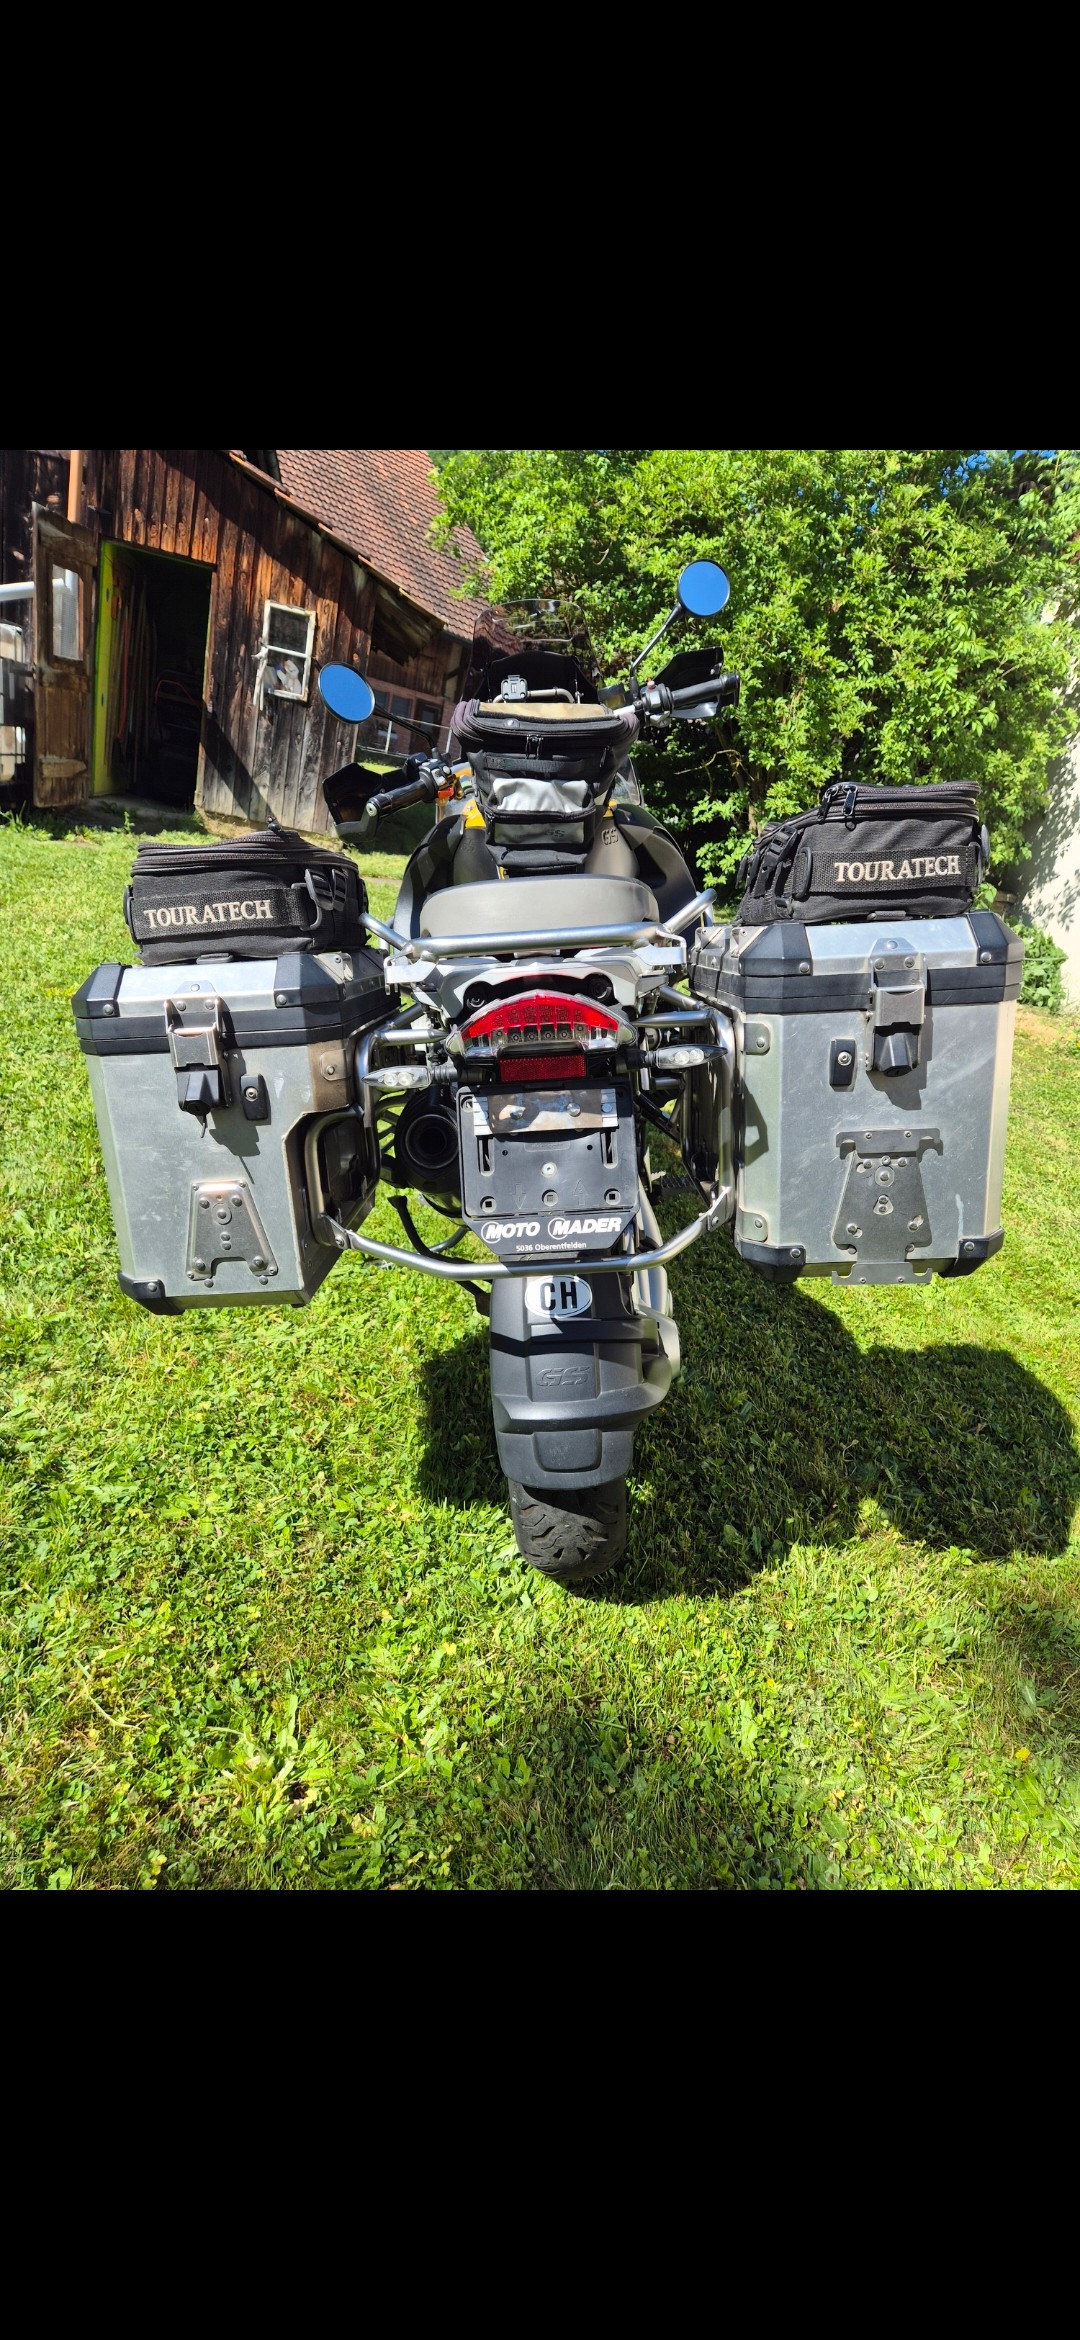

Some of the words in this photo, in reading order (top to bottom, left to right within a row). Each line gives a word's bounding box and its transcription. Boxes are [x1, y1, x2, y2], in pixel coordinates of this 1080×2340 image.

[602, 828, 619, 846] GS
[834, 855, 962, 882] TOURATECH
[143, 899, 274, 929] TOURATECH
[484, 1221, 541, 1241] MOTO
[551, 1217, 622, 1237] MADER
[515, 1243, 533, 1252] 5036
[534, 1241, 587, 1251] Oberentfelden
[540, 1281, 578, 1311] CH
[535, 1366, 591, 1387] GS
